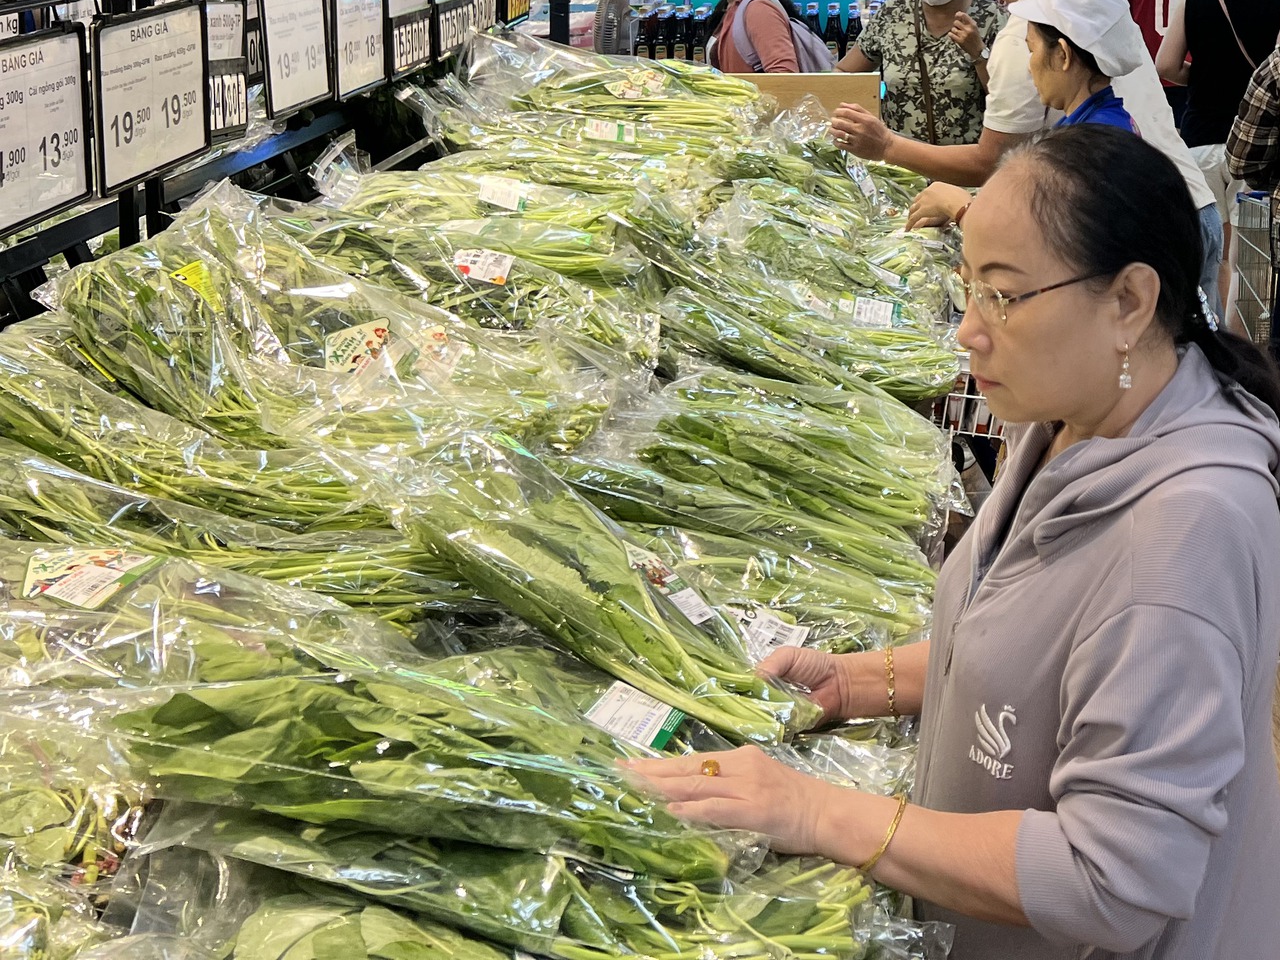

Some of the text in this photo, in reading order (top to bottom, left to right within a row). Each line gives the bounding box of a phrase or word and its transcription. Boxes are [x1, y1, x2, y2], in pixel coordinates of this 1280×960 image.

[7, 16, 18, 34] kg
[6, 91, 24, 105] 300g
[969, 745, 1014, 779] ADORE
